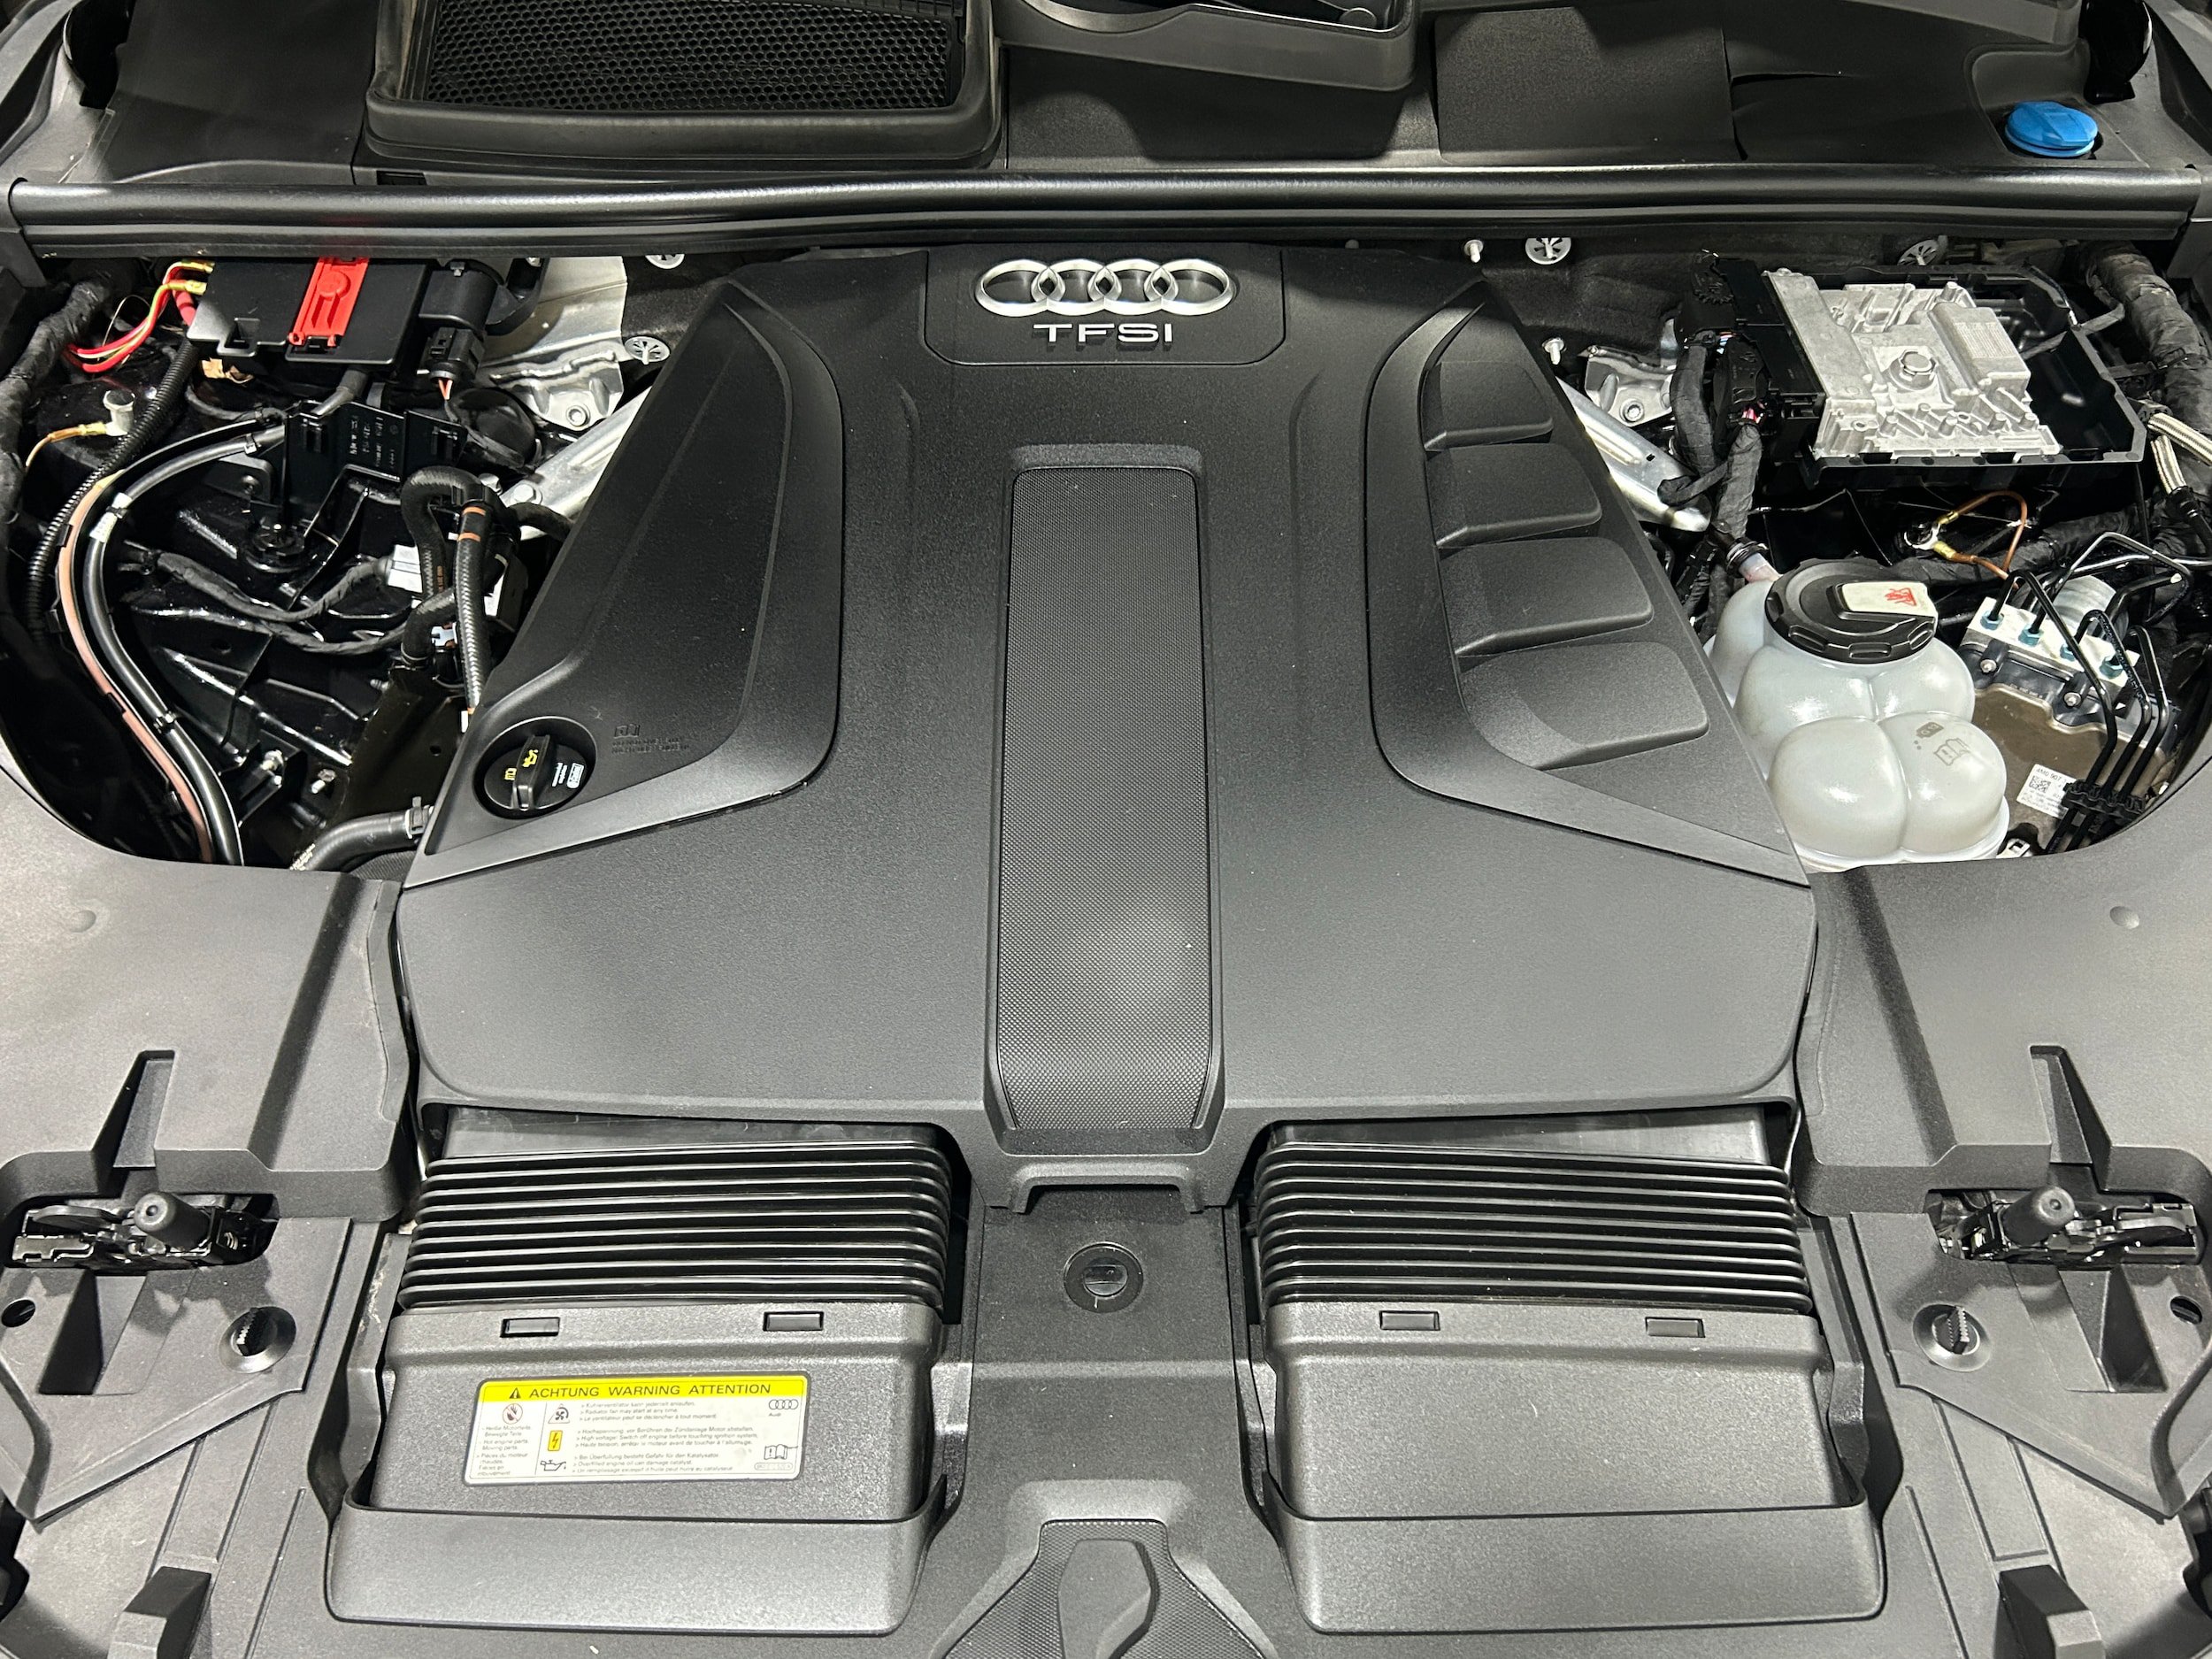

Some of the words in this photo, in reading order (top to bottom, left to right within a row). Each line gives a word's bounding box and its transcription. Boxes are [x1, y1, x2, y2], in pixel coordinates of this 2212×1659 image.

[1033, 323, 1172, 343] TFSI
[529, 1386, 600, 1398] ACHTUNG
[608, 1386, 680, 1396] WARNING
[688, 1384, 771, 1394] ATTENTION
